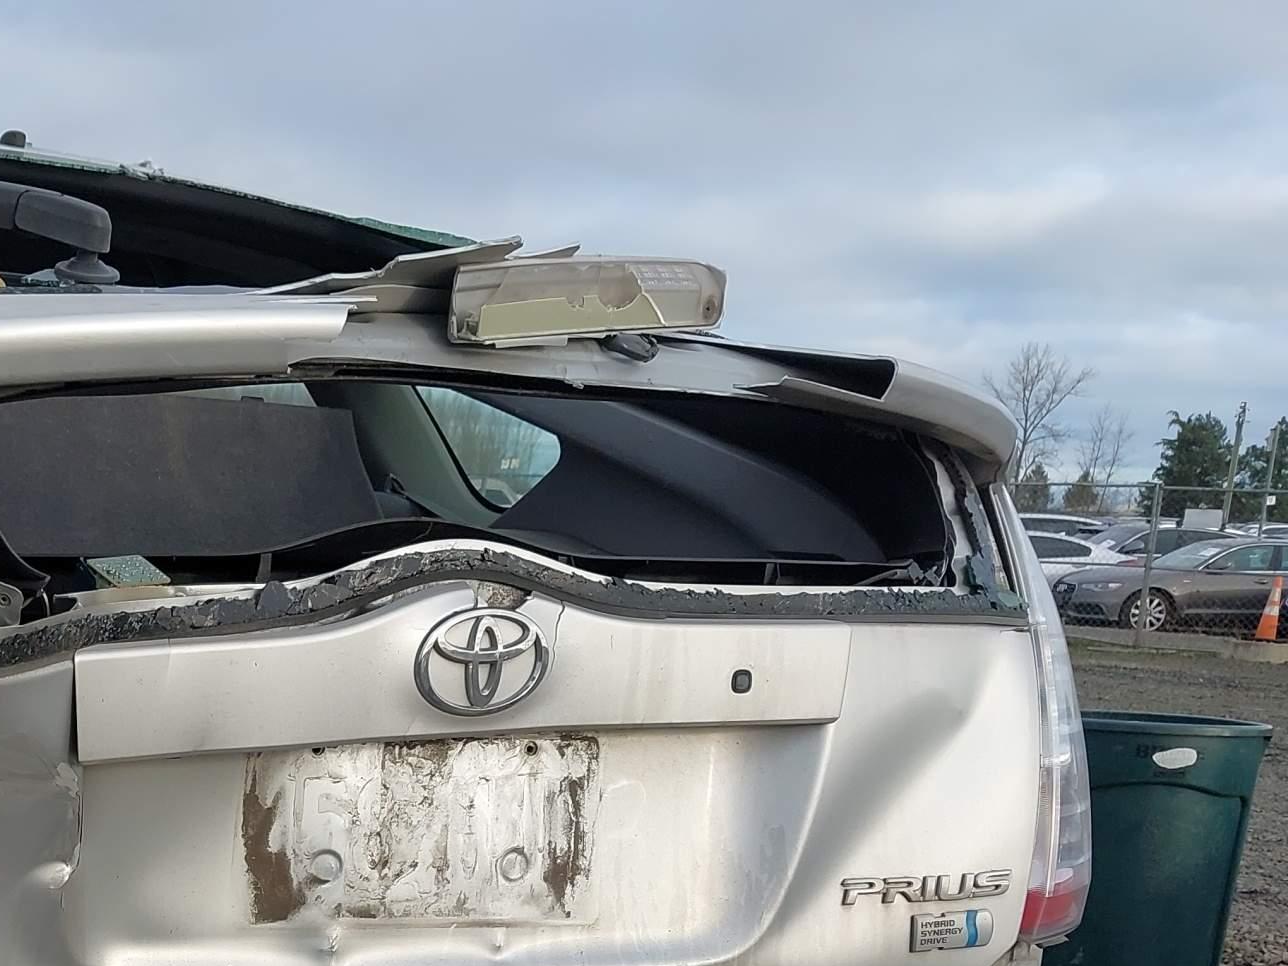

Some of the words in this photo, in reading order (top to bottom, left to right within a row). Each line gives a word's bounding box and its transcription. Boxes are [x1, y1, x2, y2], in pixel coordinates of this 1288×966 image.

[841, 869, 1012, 905] PRIUS
[920, 919, 956, 929] HYBRID
[920, 927, 963, 938] SYNERGY
[920, 936, 948, 946] DRIVE
